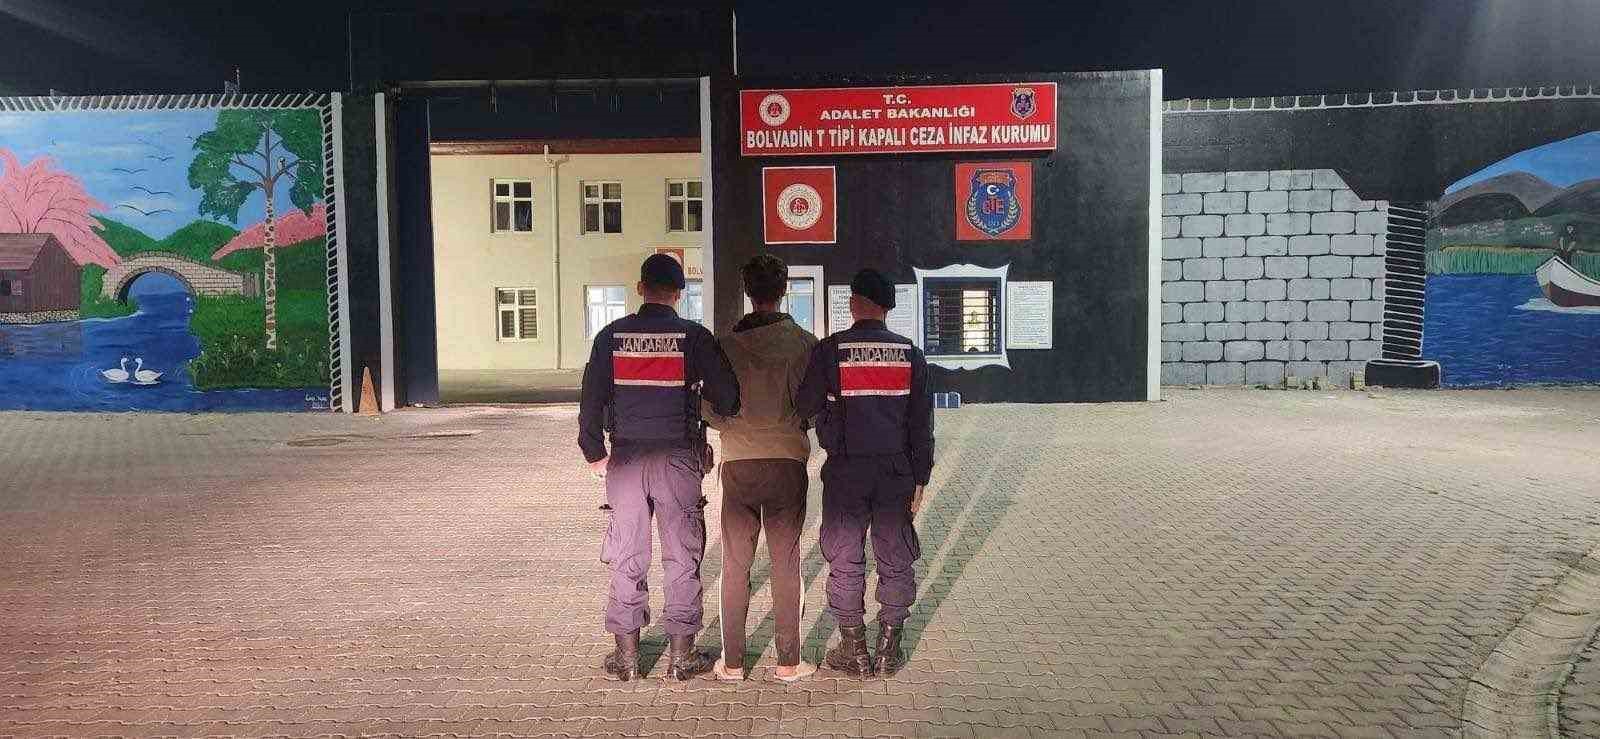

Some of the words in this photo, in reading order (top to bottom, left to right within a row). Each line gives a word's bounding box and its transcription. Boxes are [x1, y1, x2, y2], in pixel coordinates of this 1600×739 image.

[883, 94, 912, 105] T.C.
[820, 109, 882, 121] ADALET
[886, 105, 976, 119] BAKANLIĞI
[746, 126, 813, 149] BOLVADİN
[816, 128, 825, 147] T
[829, 124, 855, 147] TİPİ
[859, 126, 906, 146] KAPALI
[910, 126, 945, 146] CEZA
[949, 123, 988, 145] İNFAZ
[990, 124, 1051, 144] KURUMU
[619, 338, 679, 352] JANDARMA
[847, 348, 907, 362] JANDARMA
